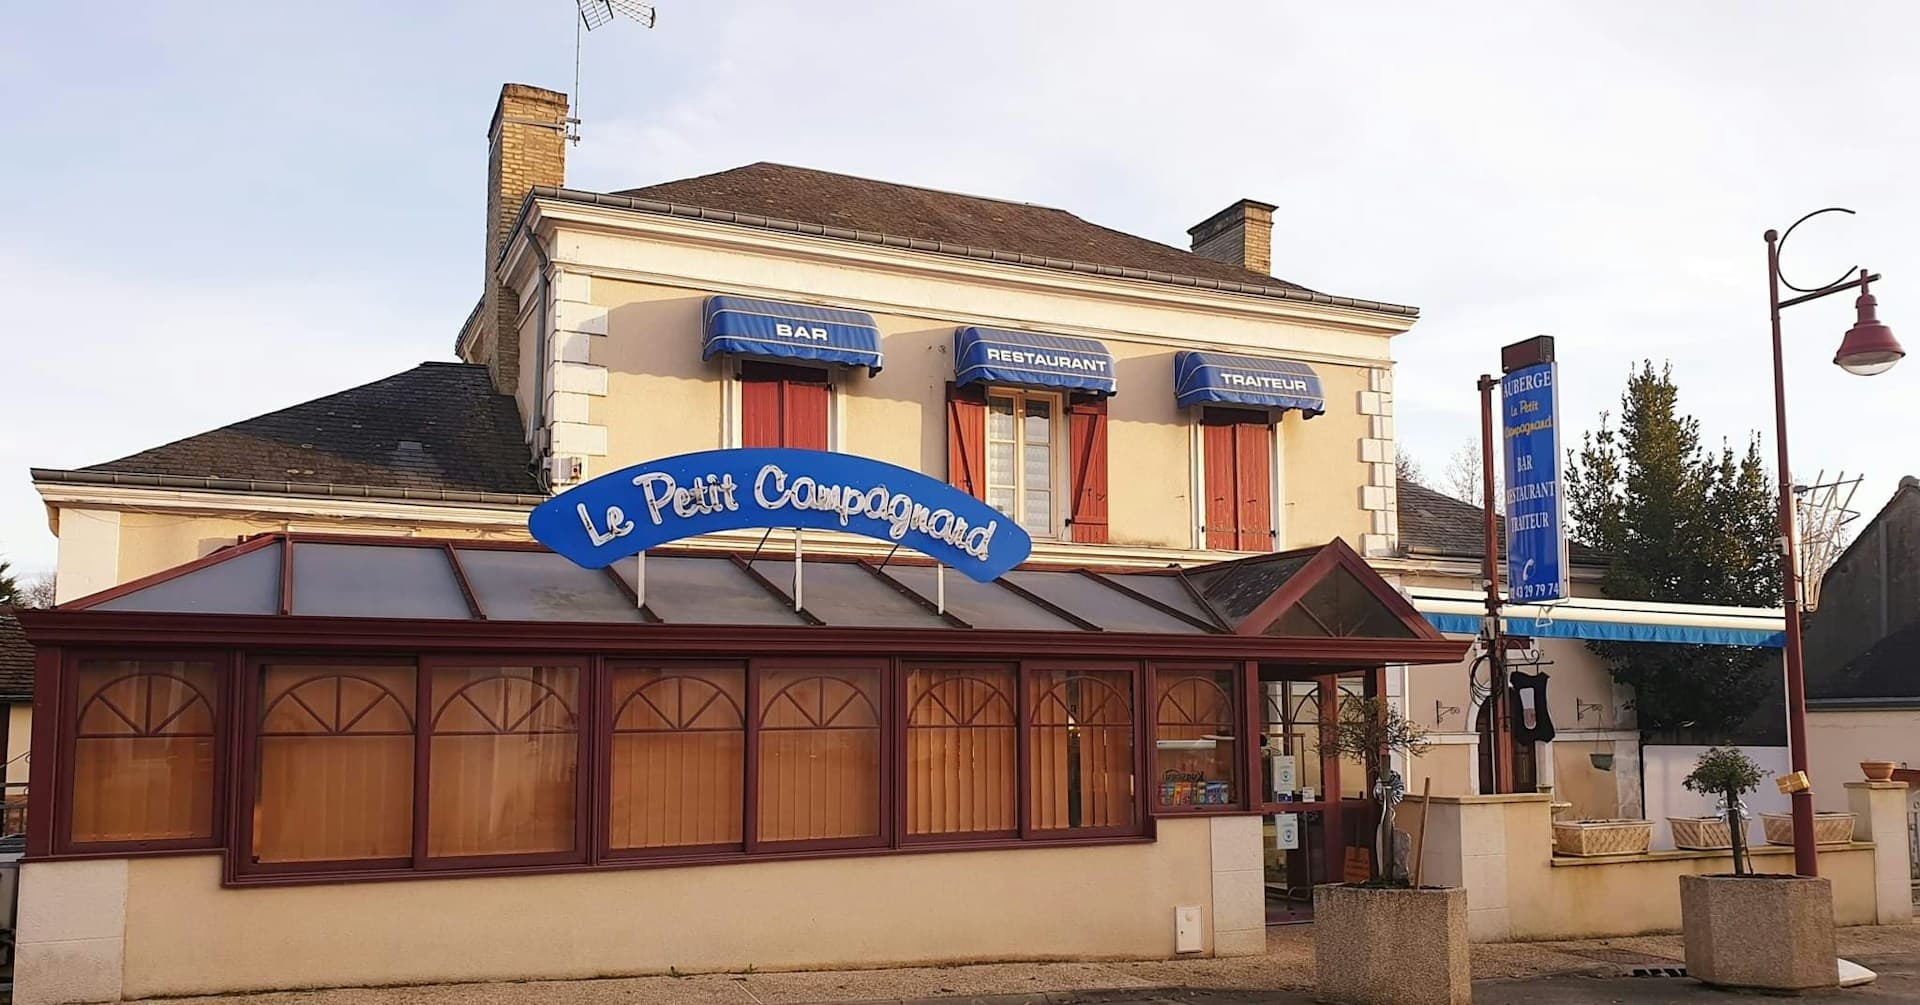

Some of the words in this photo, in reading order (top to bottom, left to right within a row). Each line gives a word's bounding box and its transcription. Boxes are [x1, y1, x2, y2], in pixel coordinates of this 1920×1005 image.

[775, 322, 829, 343] BAR
[986, 347, 1108, 374] RESTAURANT
[1221, 372, 1308, 393] TRAITEUR
[1503, 370, 1552, 399] AUBERGE
[1519, 400, 1540, 415] Petit
[1517, 453, 1533, 473] BAR
[576, 501, 635, 548] Le
[632, 471, 740, 525] Petit
[753, 464, 997, 562] Campagnard
[1510, 511, 1550, 534] TRAITEUR
[1524, 584, 1533, 598] 29
[1535, 583, 1546, 598] 79
[1548, 581, 1559, 596] 74
